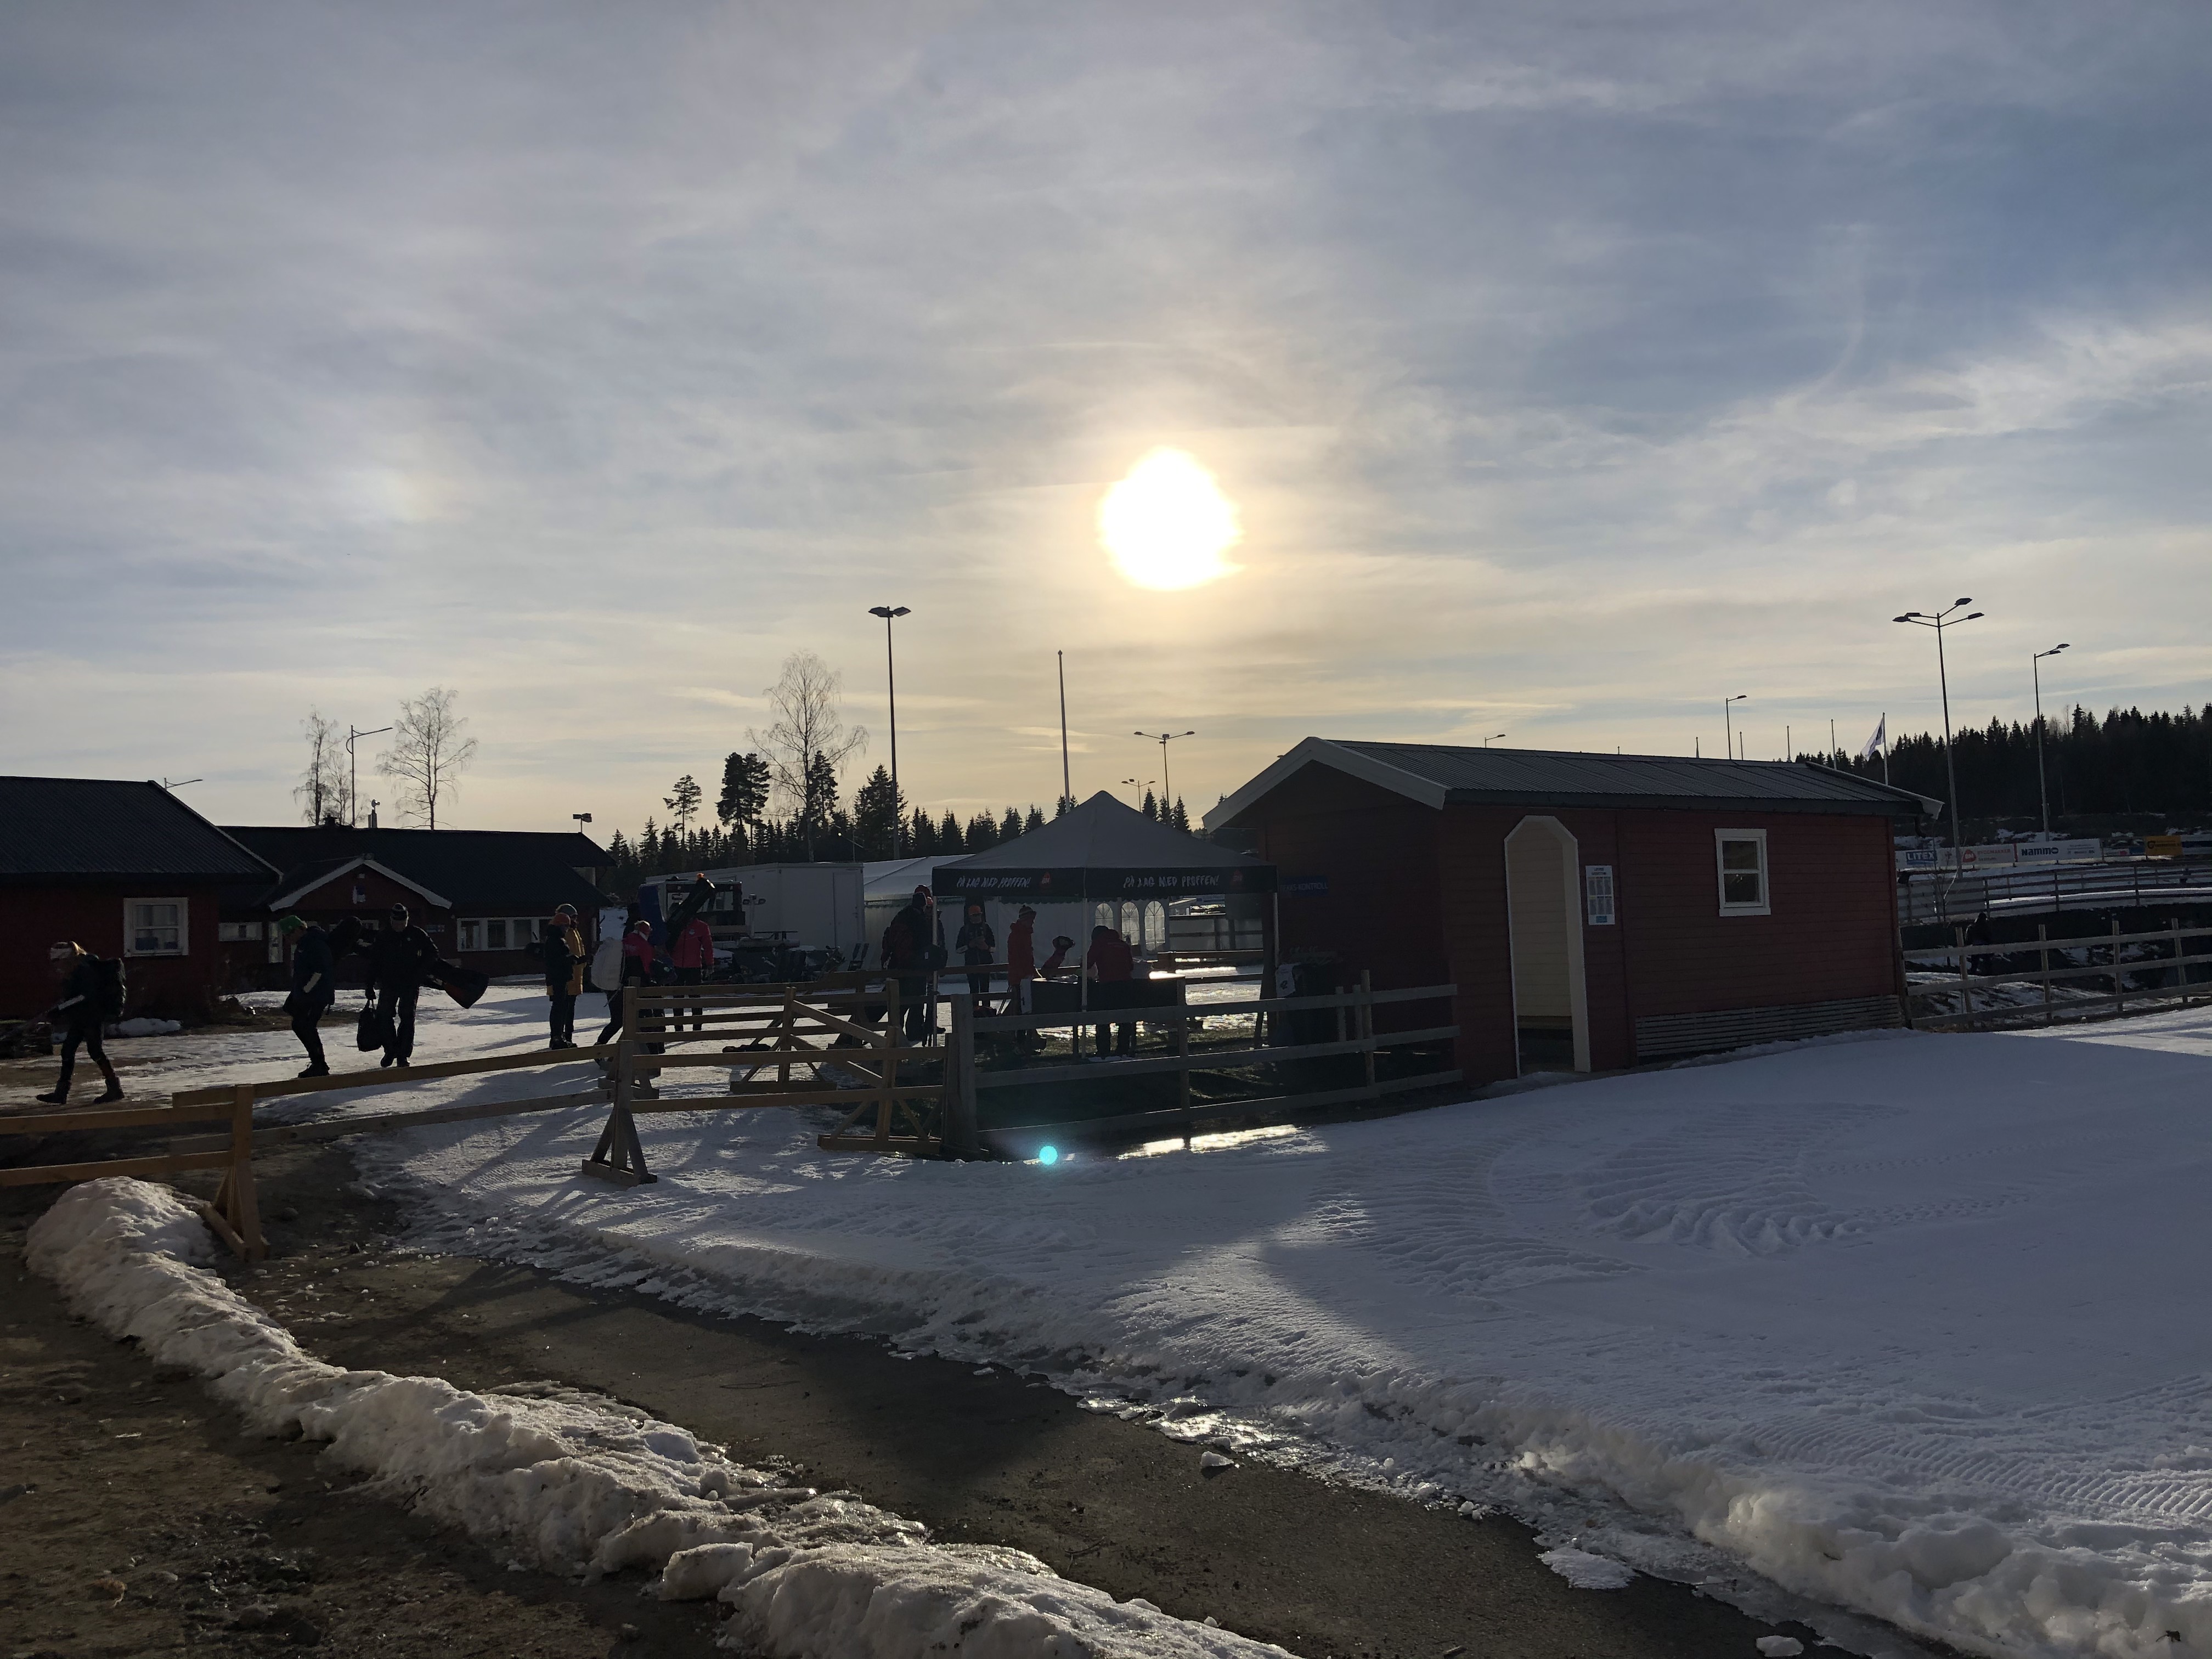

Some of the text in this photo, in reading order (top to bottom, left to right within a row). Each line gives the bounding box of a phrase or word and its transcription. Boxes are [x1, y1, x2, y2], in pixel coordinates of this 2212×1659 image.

[1907, 851, 1934, 860] LITEX
[2021, 847, 2059, 856] Nammo
[966, 877, 980, 888] LAG
[980, 877, 998, 888] MED
[1124, 875, 1135, 888] PÅ
[1137, 877, 1155, 887] LAG
[1159, 876, 1177, 887] MED
